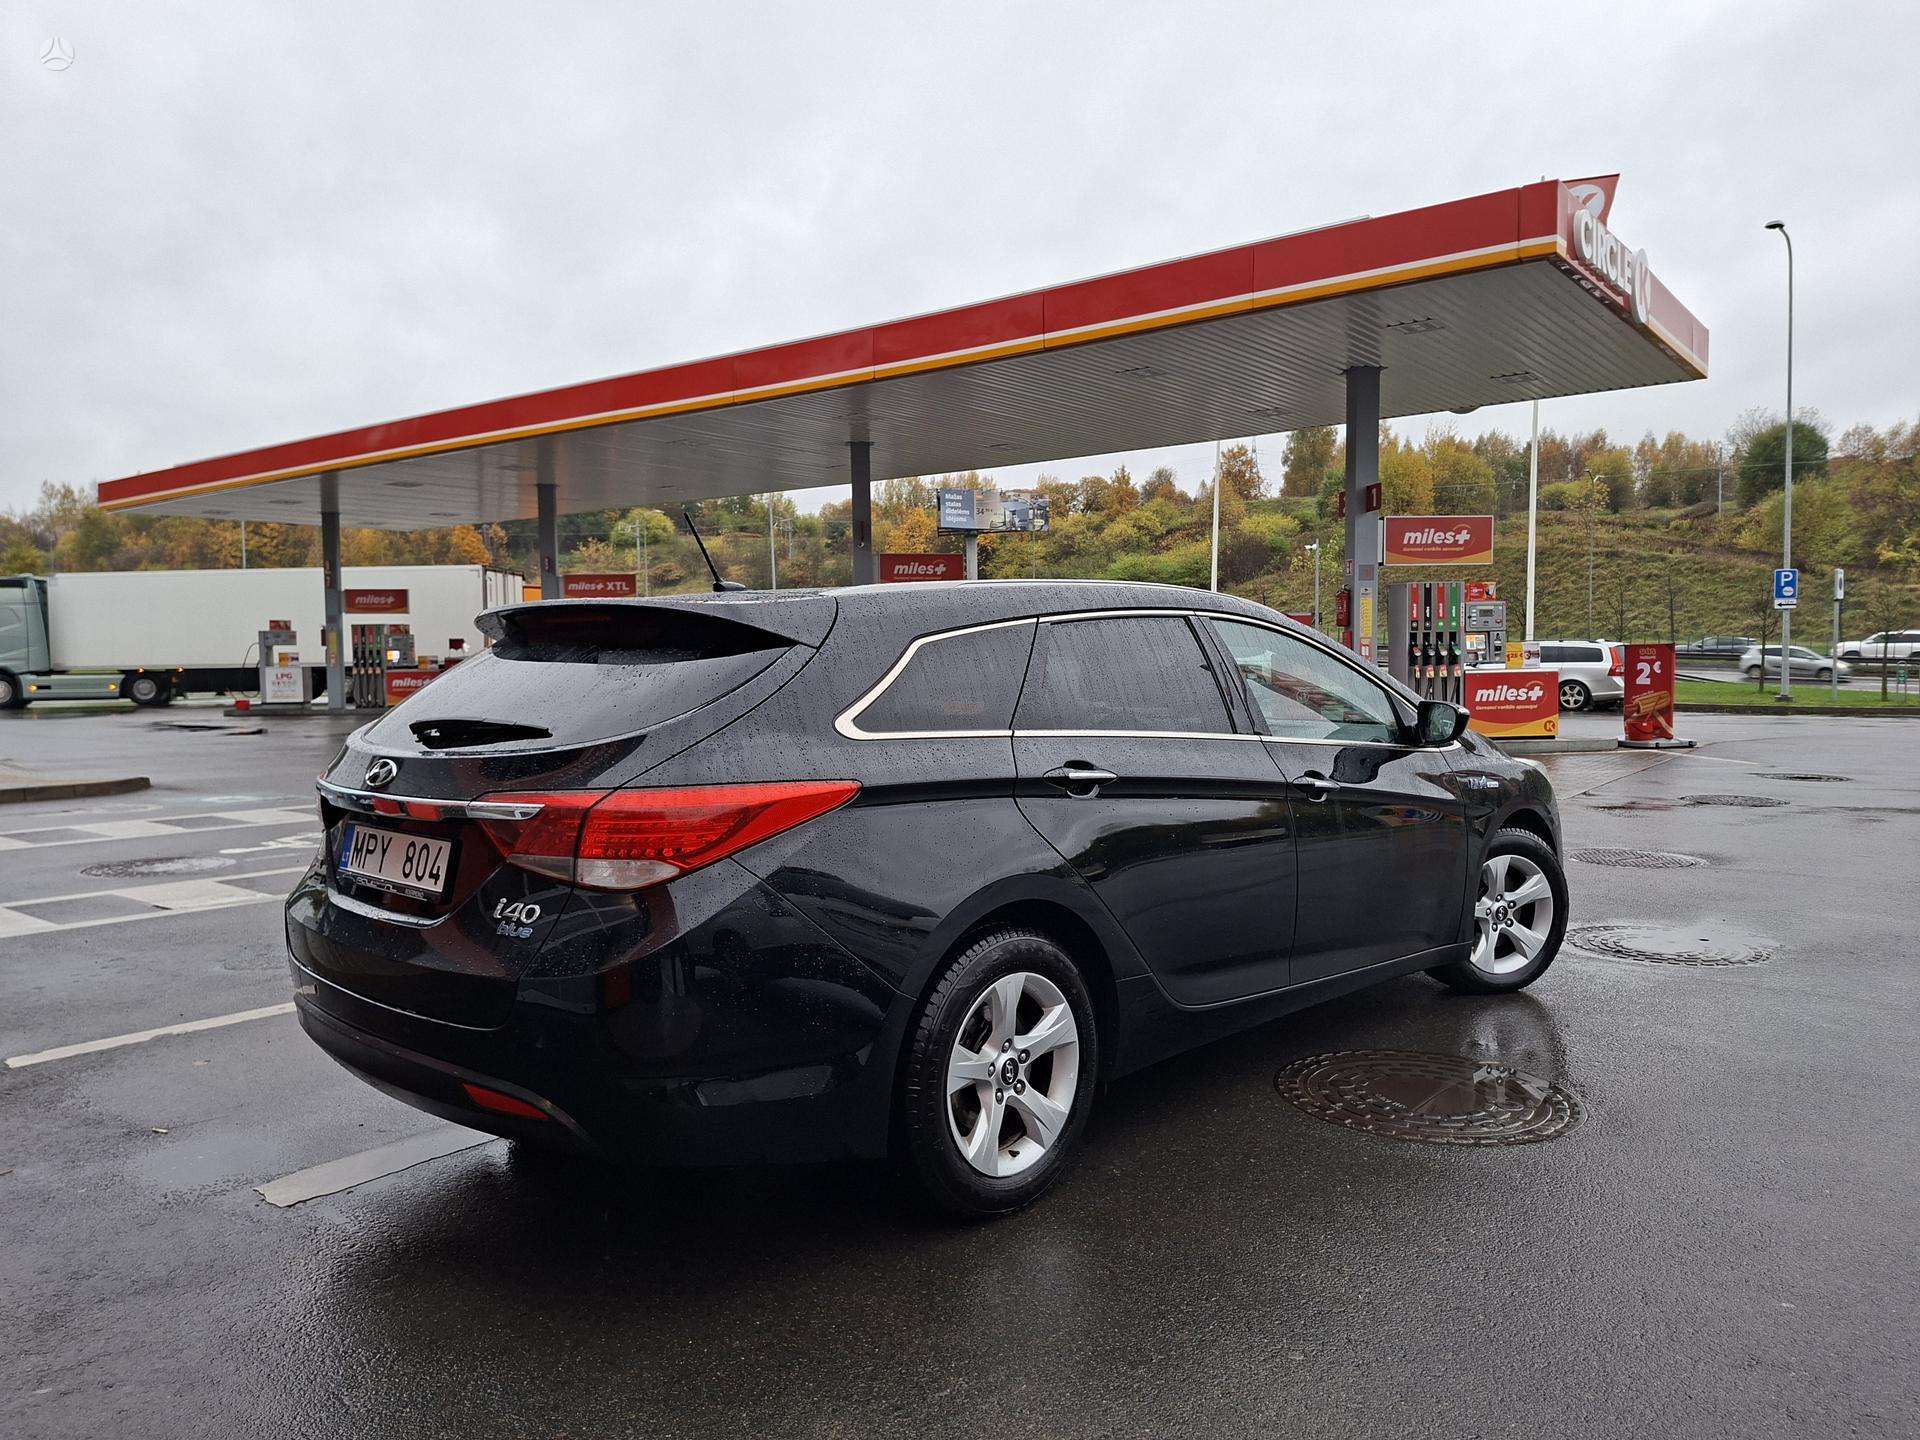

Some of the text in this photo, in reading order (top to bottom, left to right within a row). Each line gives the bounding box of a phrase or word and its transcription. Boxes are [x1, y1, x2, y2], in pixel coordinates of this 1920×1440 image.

[1574, 209, 1632, 296] CIRCLE
[1371, 487, 1377, 507] 1
[1403, 528, 1471, 545] miles+
[893, 562, 947, 575] miles+
[568, 581, 630, 591] miles+ XTL
[1781, 572, 1793, 586] P
[355, 594, 395, 604] miles+
[1475, 685, 1544, 702] miles+
[350, 830, 443, 886] MPY 804
[493, 897, 541, 924] i40
[496, 920, 533, 939] blue
